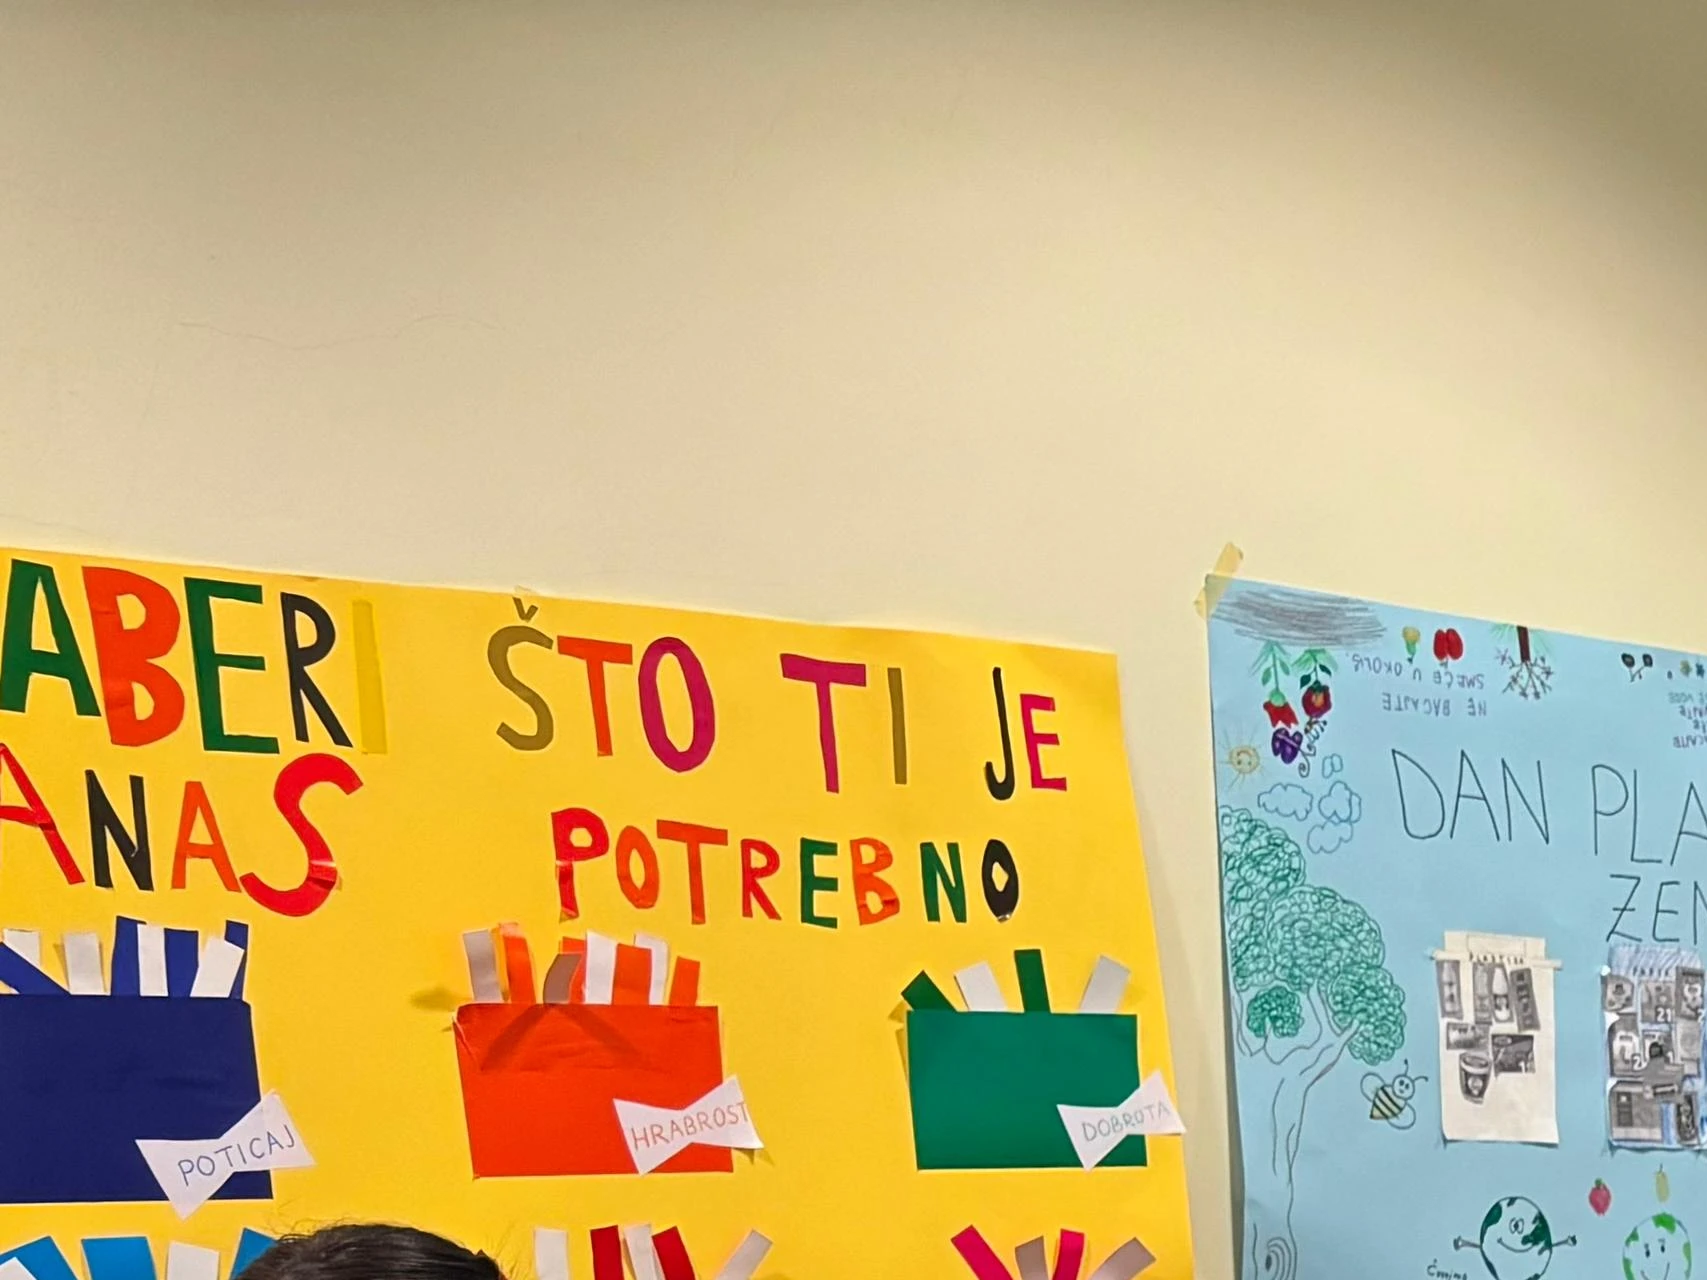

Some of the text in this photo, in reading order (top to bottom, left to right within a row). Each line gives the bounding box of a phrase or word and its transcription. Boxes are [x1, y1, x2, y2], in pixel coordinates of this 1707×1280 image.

[487, 596, 716, 773] ŠTO
[779, 653, 908, 794] TI
[984, 666, 1068, 801] JE
[1381, 691, 1451, 717] BACAJTE
[1389, 748, 1551, 846] DAN
[550, 807, 1020, 929] POTREBNO
[630, 1101, 749, 1151] HRABROST
[1081, 1101, 1171, 1142] DOBROTA
[177, 1124, 296, 1187] POTICAJ
